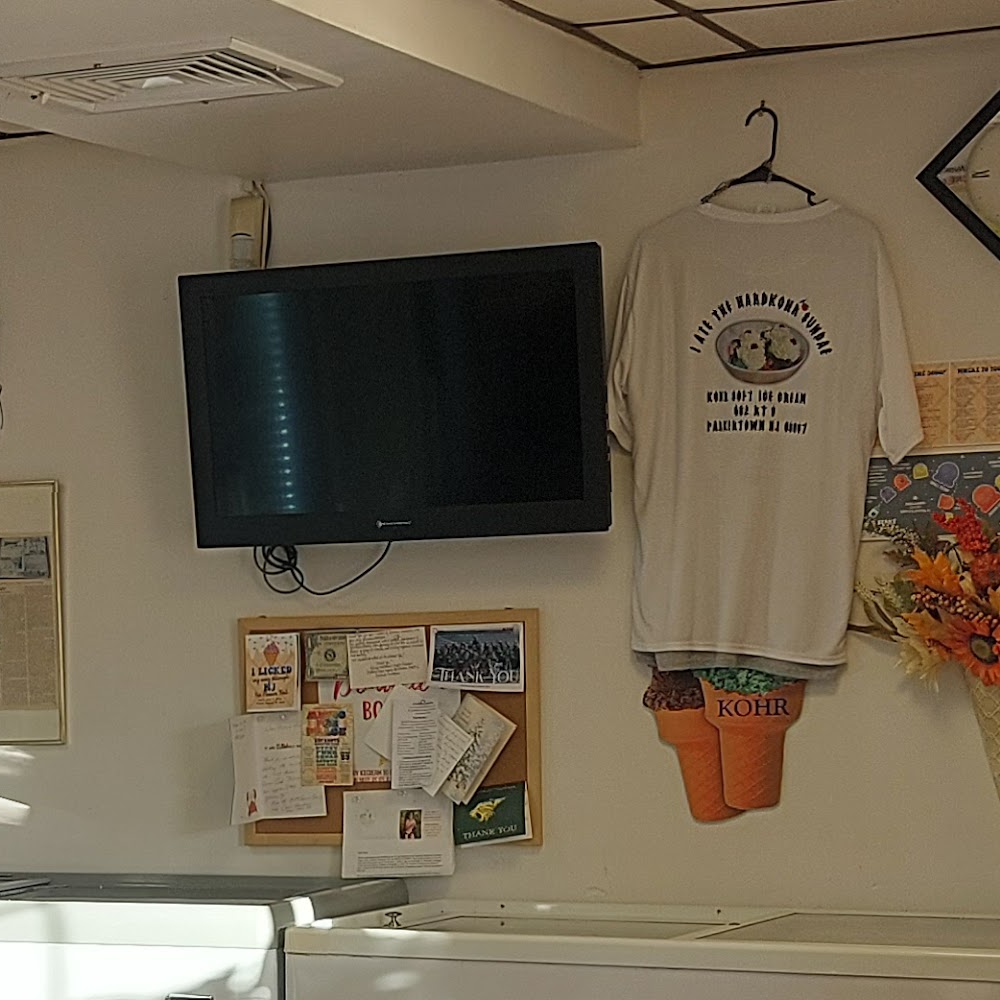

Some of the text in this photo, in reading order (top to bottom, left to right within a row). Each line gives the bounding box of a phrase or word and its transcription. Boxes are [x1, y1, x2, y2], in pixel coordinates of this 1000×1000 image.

[694, 320, 713, 345] ATE
[712, 300, 733, 321] THE
[801, 312, 833, 356] SUNDAE
[758, 390, 774, 403] ICE
[777, 391, 807, 405] CREAM
[251, 666, 292, 677] I LICKED
[717, 698, 790, 717] KOHR
[463, 824, 518, 840] THANK YOU
